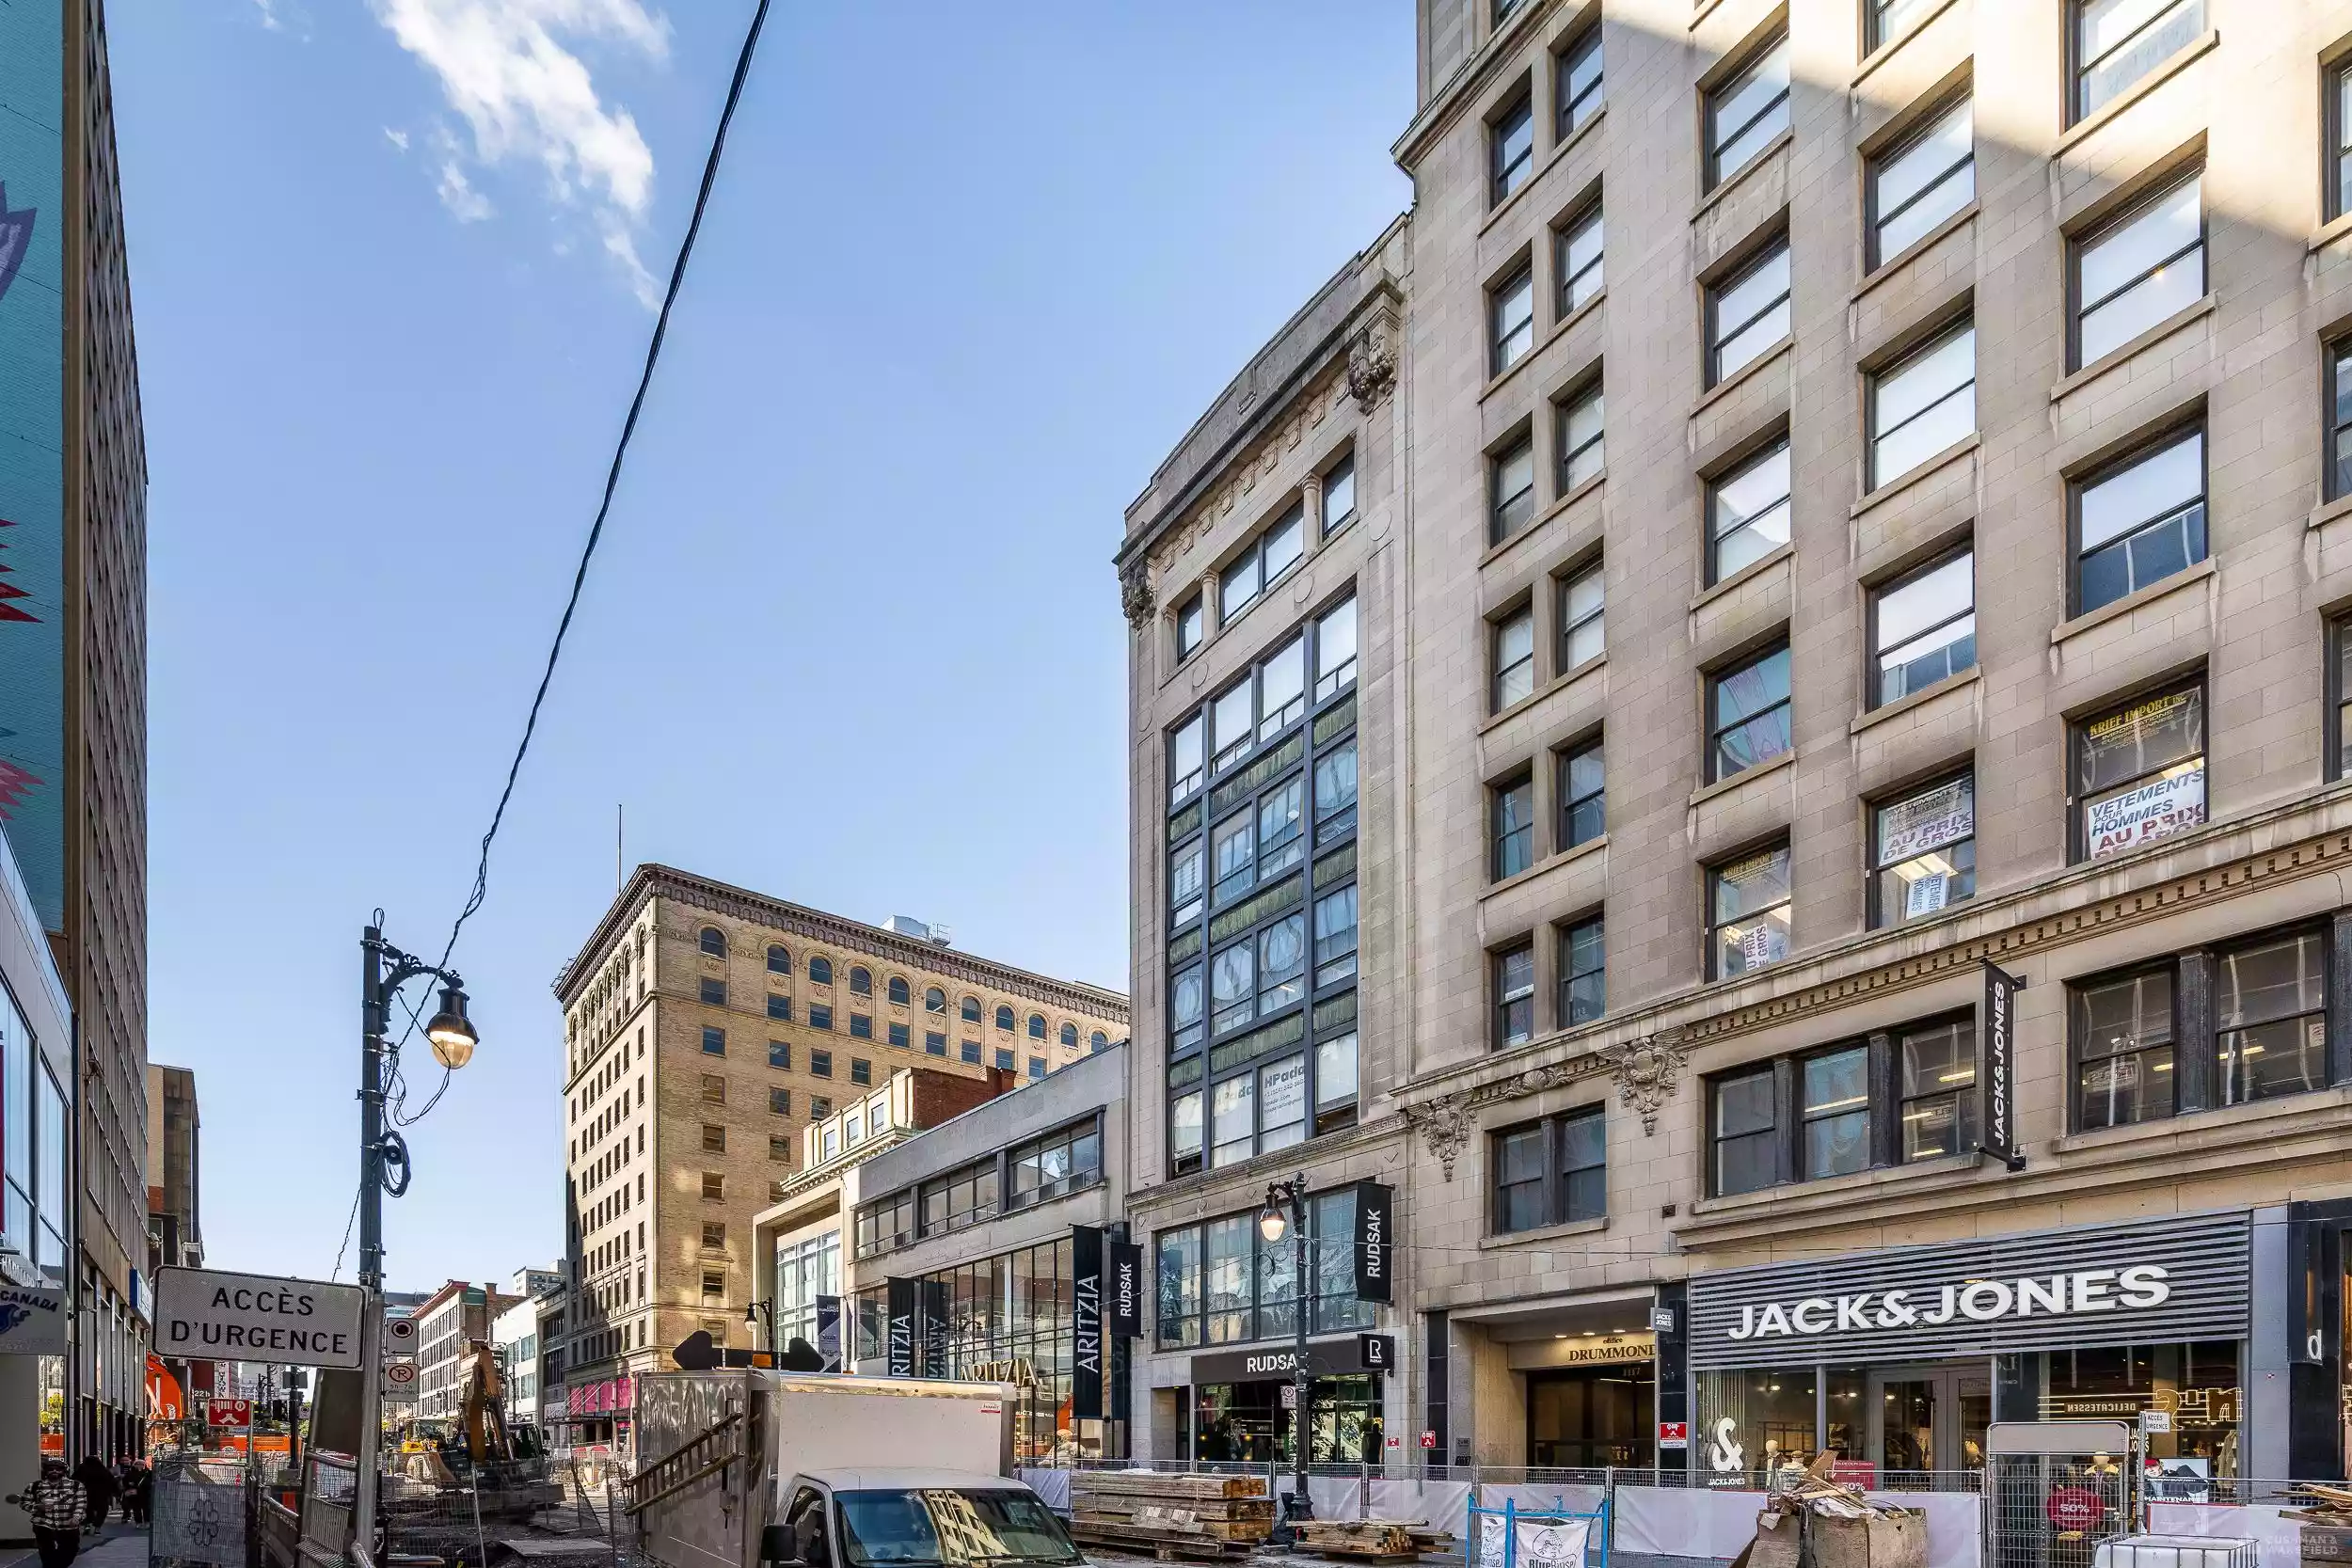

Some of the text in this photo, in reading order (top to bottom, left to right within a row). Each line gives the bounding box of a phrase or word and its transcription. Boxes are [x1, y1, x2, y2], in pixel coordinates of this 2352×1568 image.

[2090, 715, 2122, 736] KRIEF
[2125, 696, 2169, 722] IMPORT
[2092, 768, 2202, 817] VETEMENTS
[1889, 811, 1972, 849] AU PRIX
[2092, 799, 2173, 836] HOMMES
[2095, 809, 2122, 824] POUR
[2099, 828, 2132, 850] AU
[2142, 803, 2202, 835] PRIX
[1883, 821, 1973, 860] DE GROS
[1745, 932, 1756, 958] PRIX
[1756, 927, 1768, 957] GROS
[1994, 982, 2005, 1147] JACK&JONES
[1367, 1208, 1381, 1277] RUDSAK
[0, 1291, 58, 1312] CANADA
[211, 1287, 313, 1316] ACCÈS
[1120, 1262, 1132, 1317] RUDSAK
[1727, 1265, 2169, 1340] JACK&JONES
[171, 1321, 347, 1354] D'URGENCE
[1077, 1275, 1099, 1373] ARITZIA
[891, 1315, 911, 1376] RITZIA
[1248, 1354, 1298, 1372] RUDSA
[961, 1358, 1038, 1386] ARITZIA
[2060, 1503, 2090, 1513] 50%
